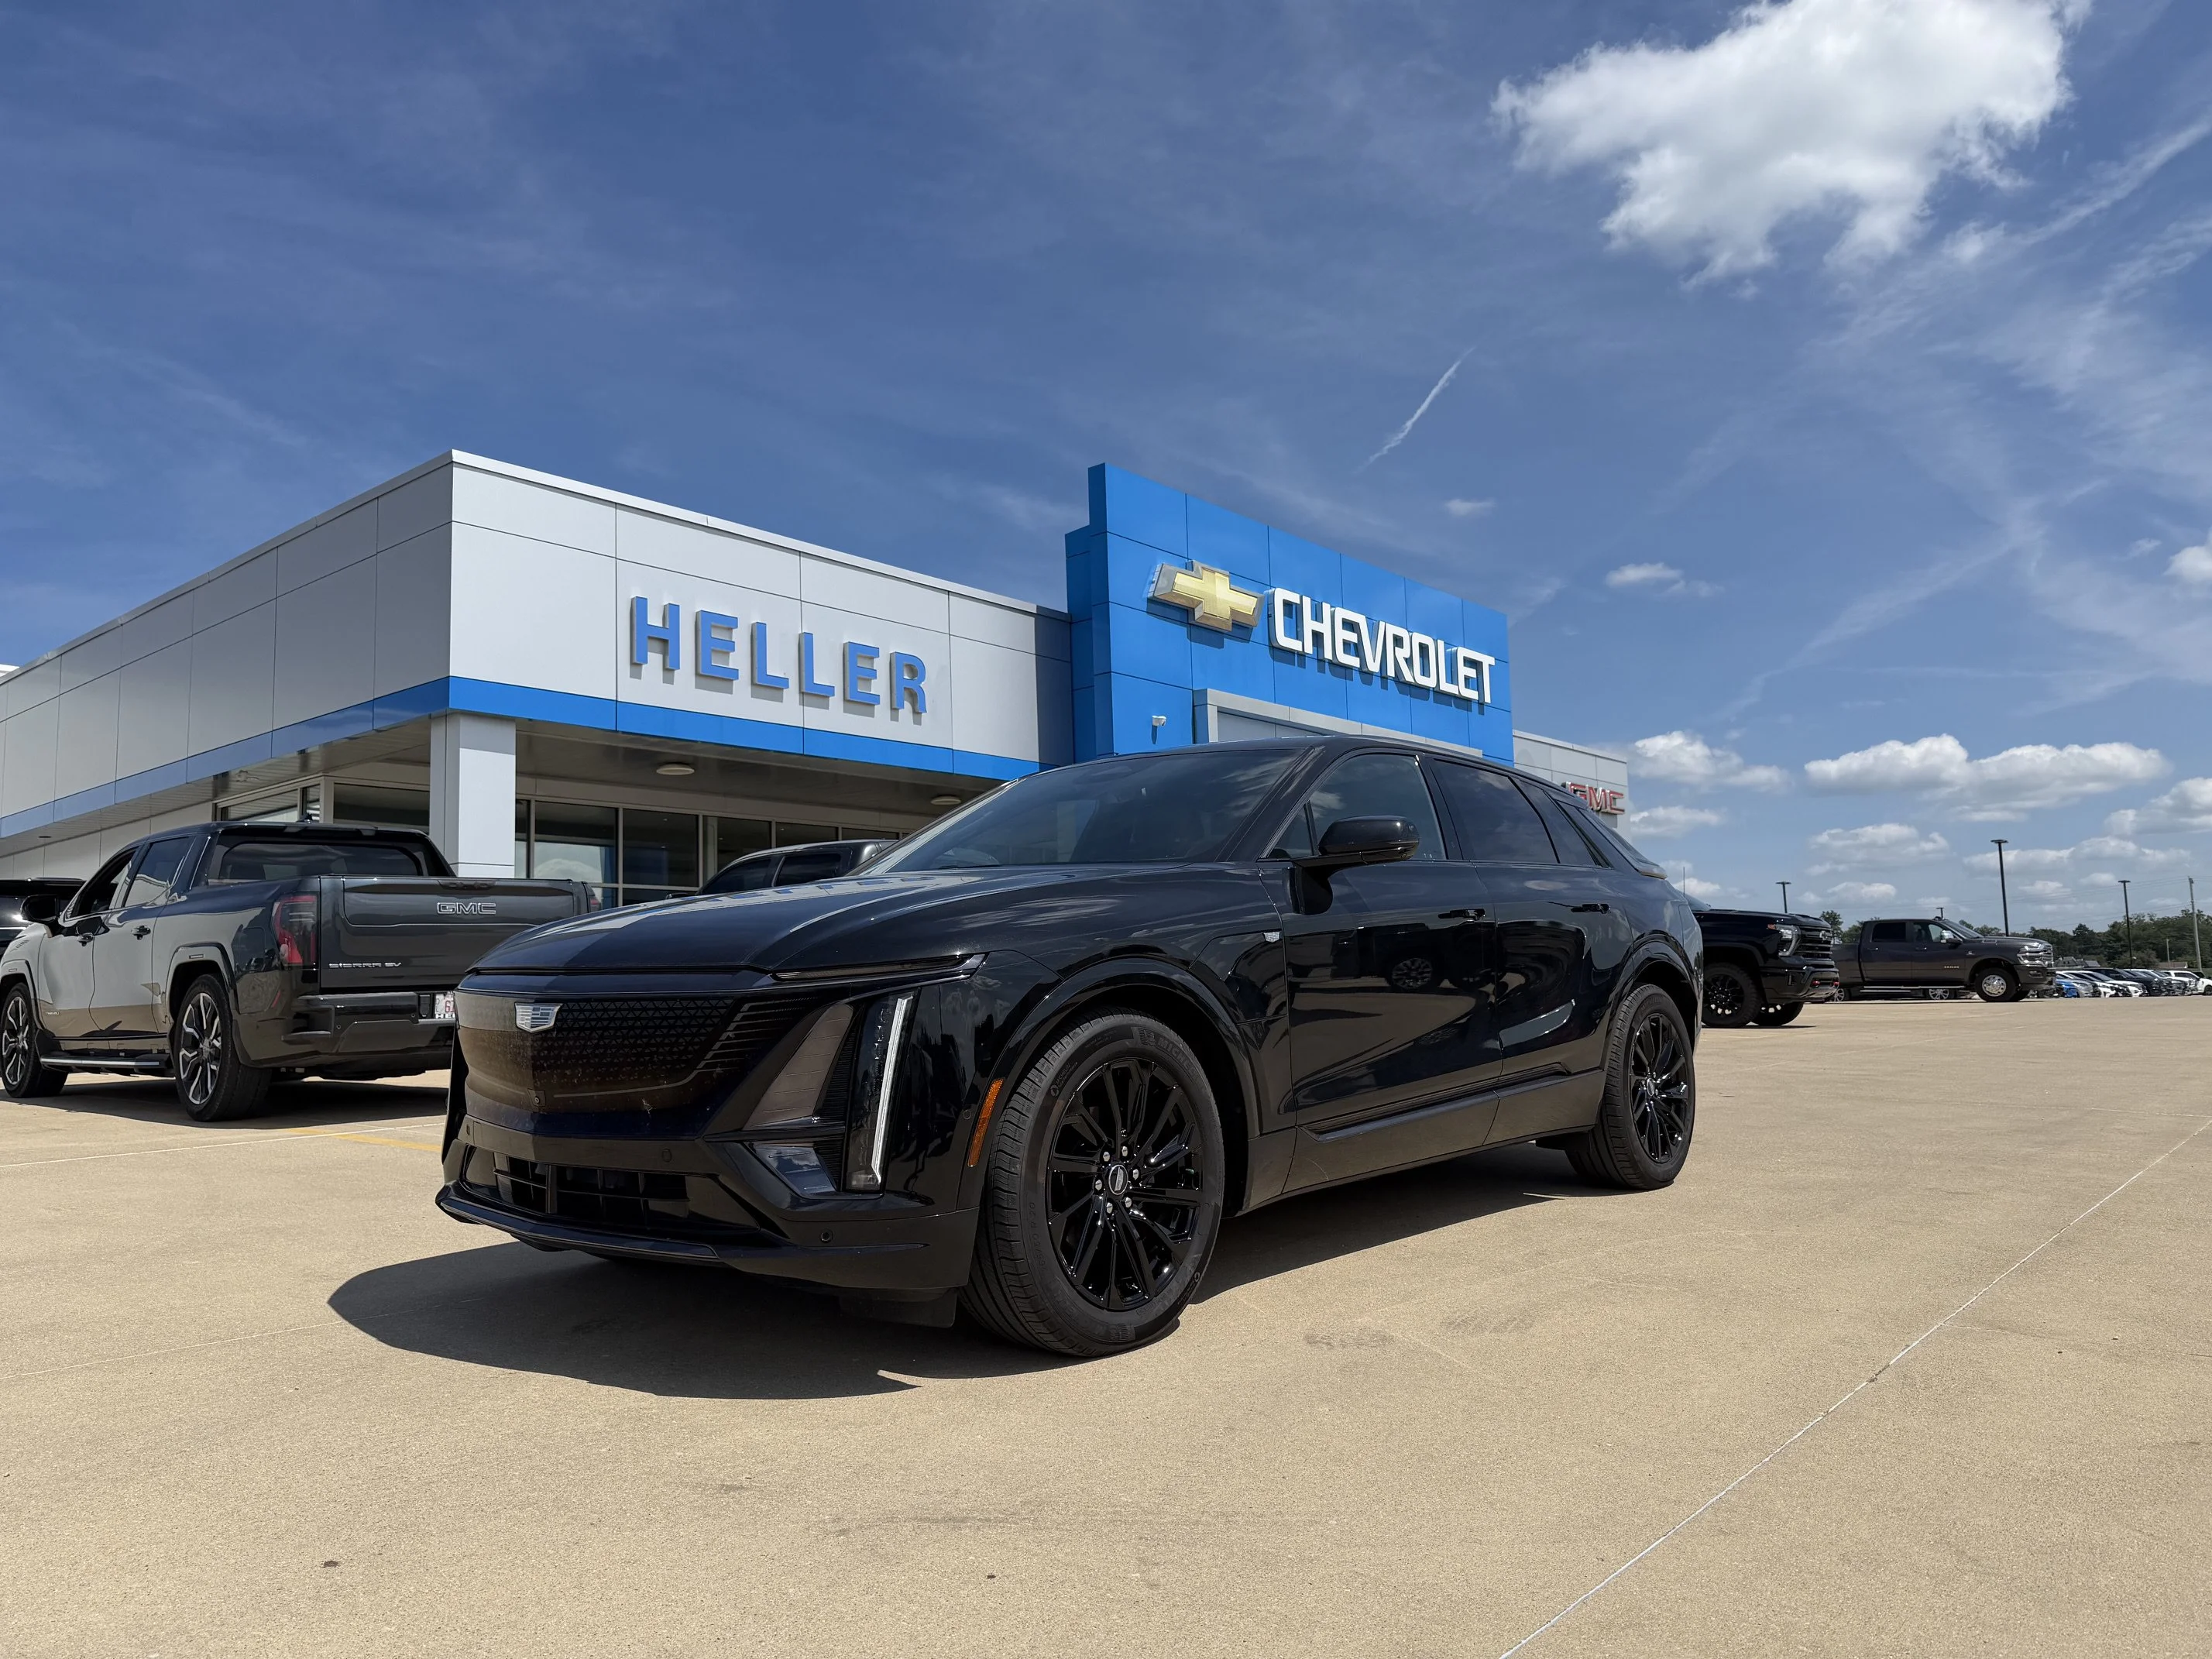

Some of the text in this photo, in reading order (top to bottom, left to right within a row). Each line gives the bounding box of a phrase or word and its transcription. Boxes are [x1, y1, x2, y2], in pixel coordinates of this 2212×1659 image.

[630, 596, 928, 714] HELLER
[1269, 587, 1496, 704] CHEVROLET
[437, 902, 496, 914] GMC
